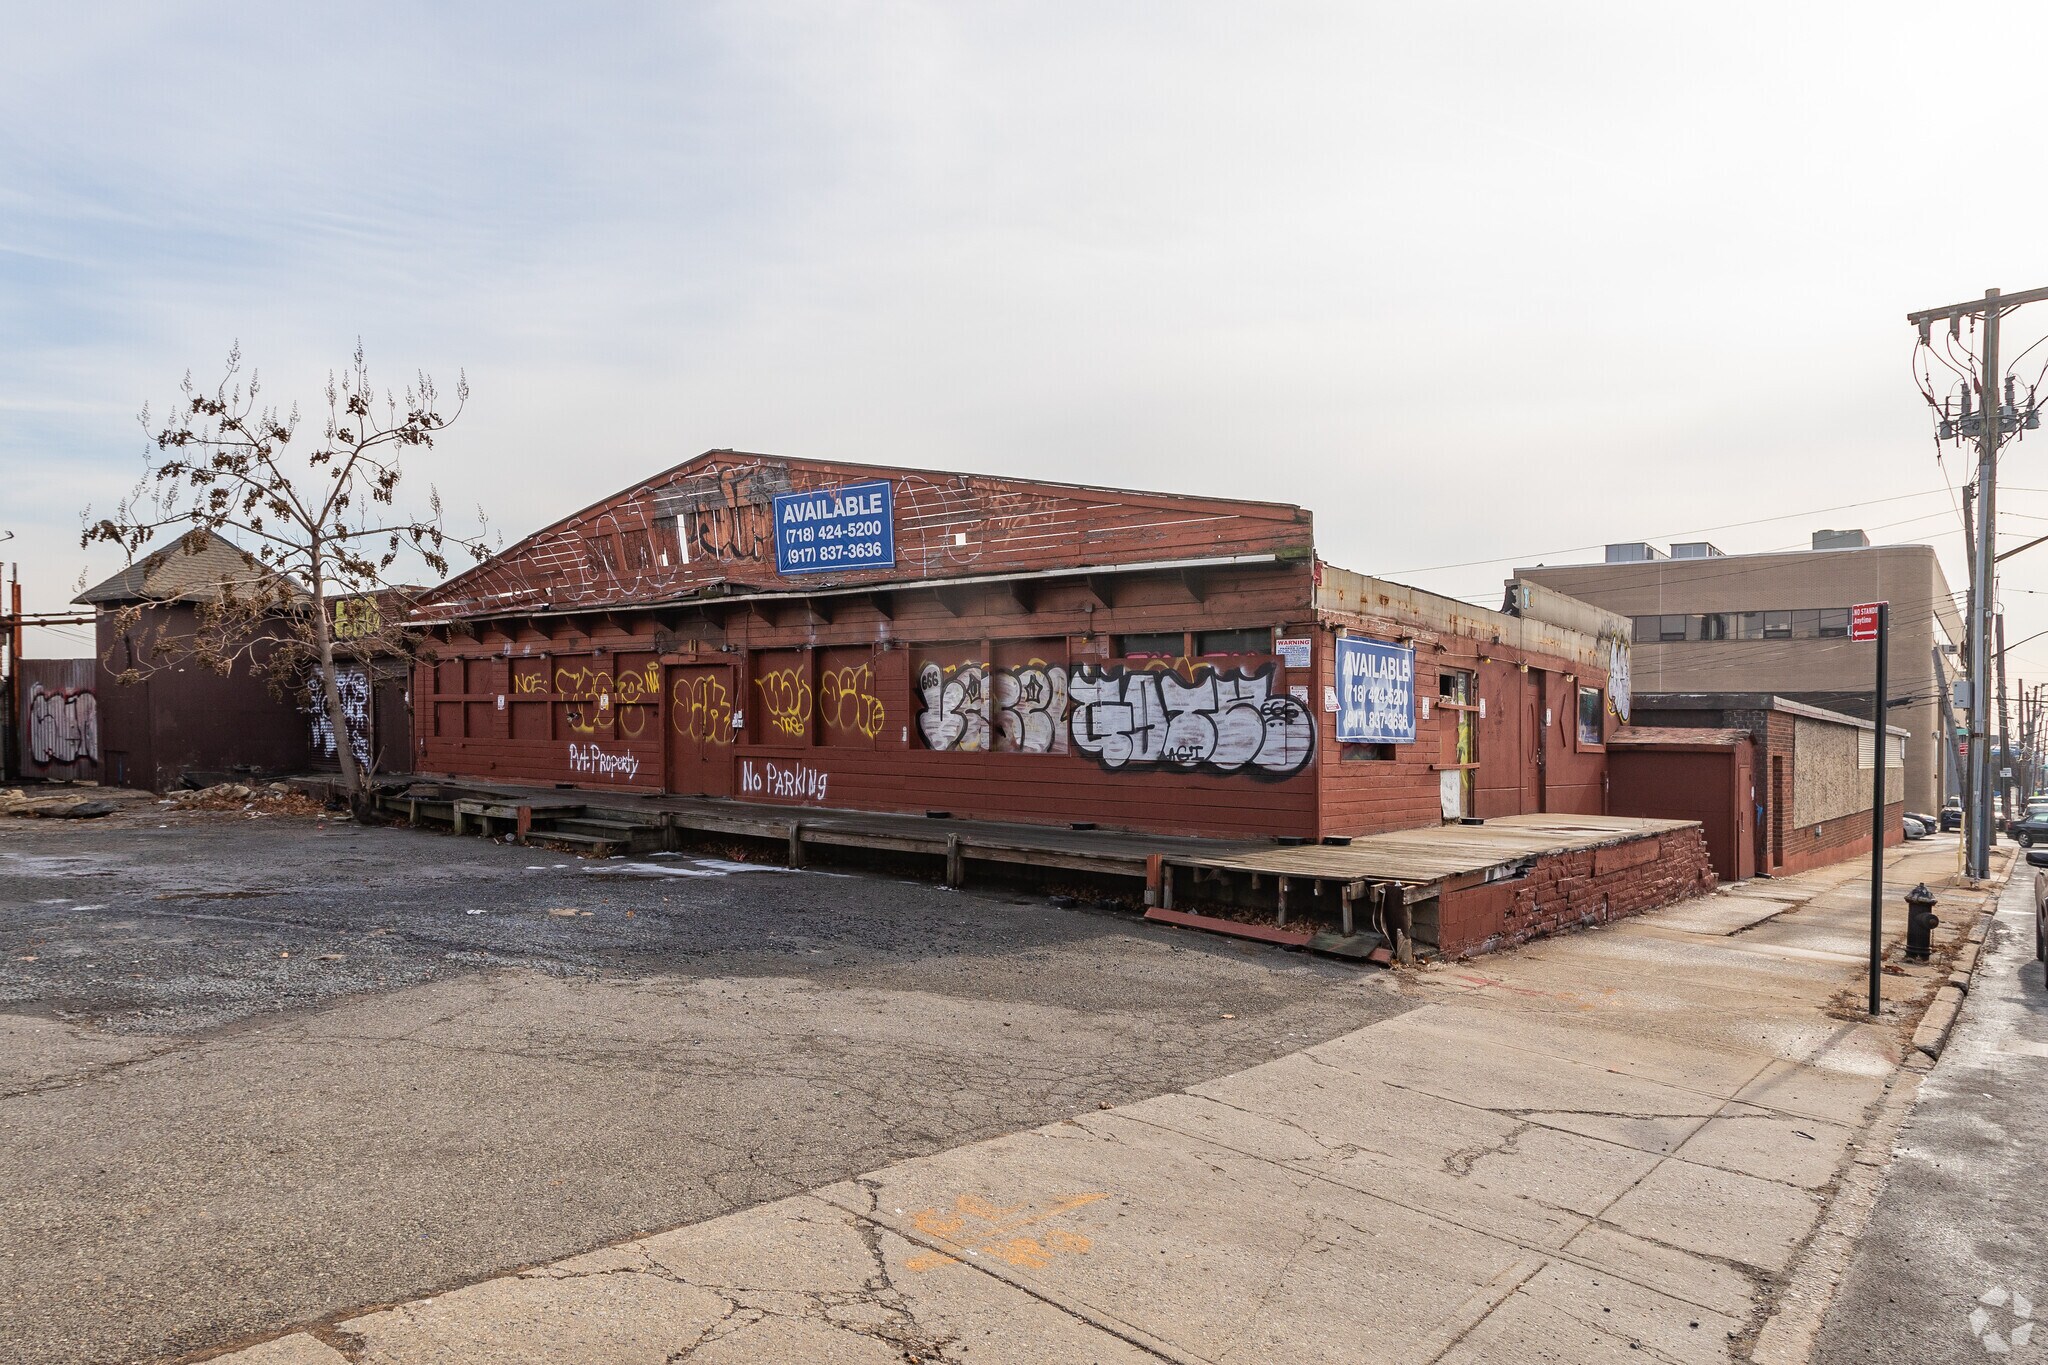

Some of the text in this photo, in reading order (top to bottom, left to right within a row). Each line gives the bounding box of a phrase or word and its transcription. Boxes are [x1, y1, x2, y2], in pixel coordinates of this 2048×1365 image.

[783, 493, 883, 524] AVAILABLE
[786, 520, 882, 544] (718) 424-5200
[788, 542, 882, 564] (917) 837-3636
[1854, 616, 1872, 625] Anytime
[1343, 651, 1411, 682] AVAILABLE
[922, 670, 939, 690] 666
[1344, 683, 1366, 704] (718)
[1368, 686, 1409, 706] 424-5200
[1345, 709, 1408, 730] (917) 837-3636
